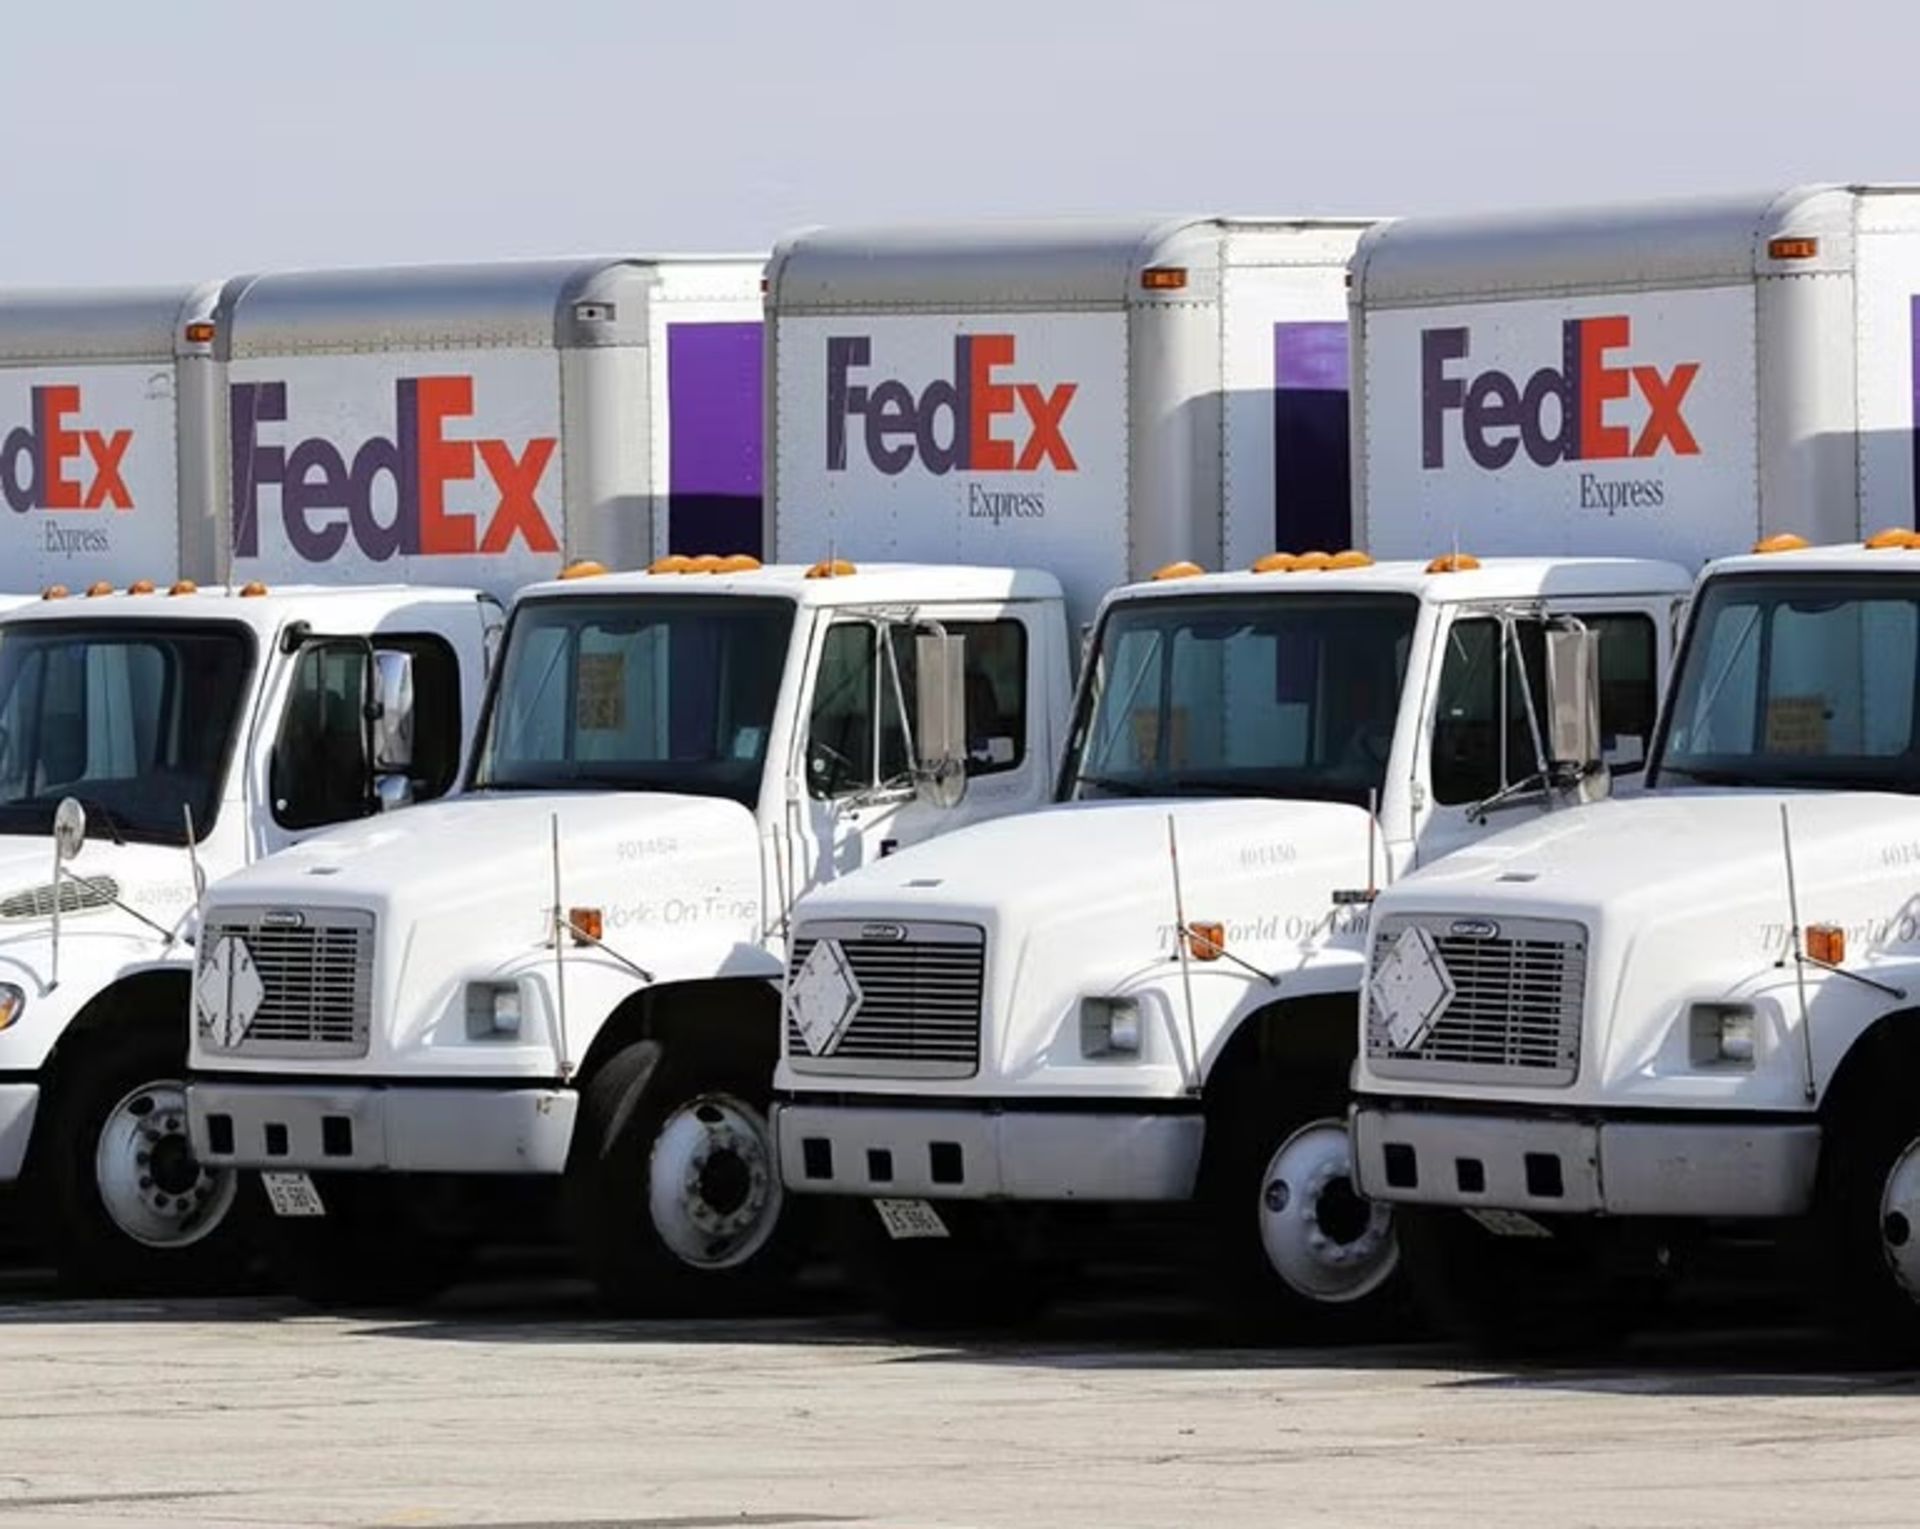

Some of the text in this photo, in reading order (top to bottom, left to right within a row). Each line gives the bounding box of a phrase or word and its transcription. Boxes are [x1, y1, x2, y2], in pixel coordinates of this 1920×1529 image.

[826, 334, 1079, 475] FedEx
[1421, 315, 1701, 471] FedEx
[0, 385, 134, 513] dEx
[230, 374, 560, 562] FedEx
[968, 482, 1045, 525] Express
[1580, 472, 1665, 515] Express
[44, 519, 110, 559] Express
[1224, 914, 1279, 942] orld
